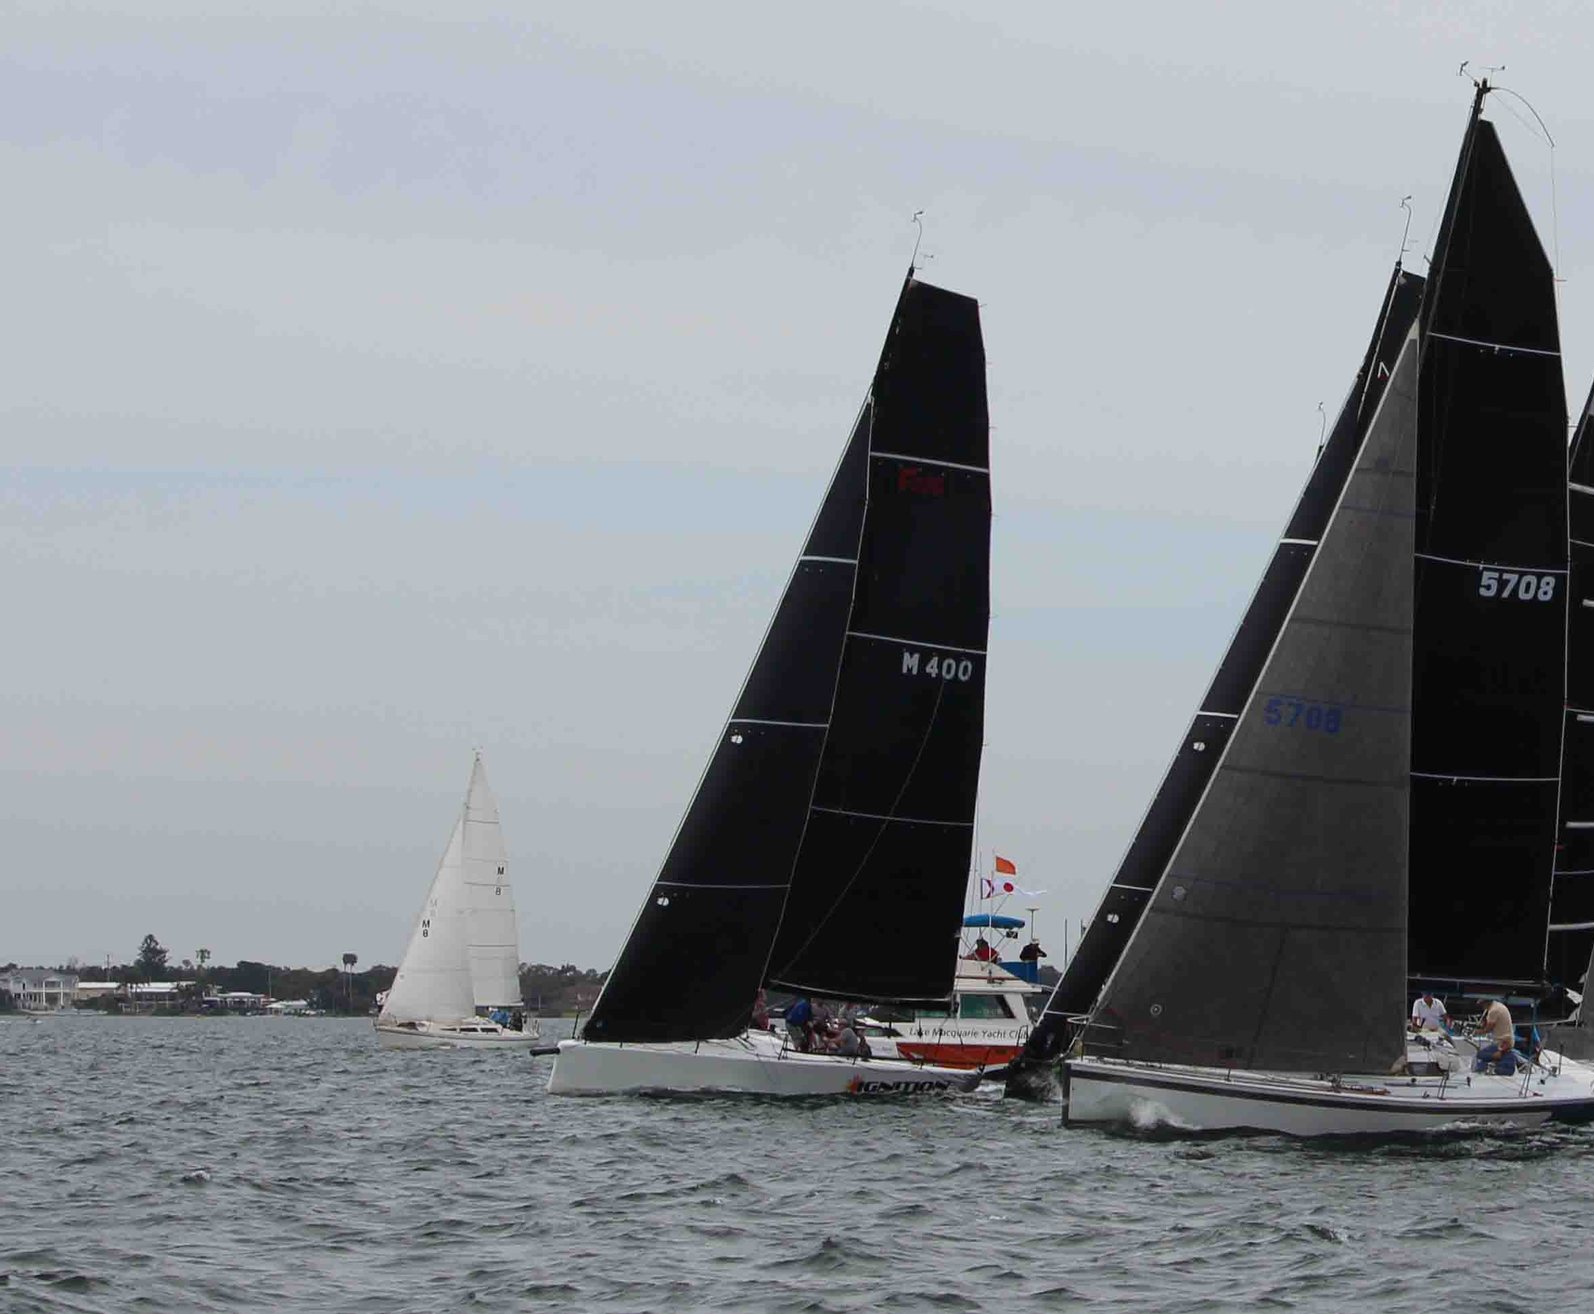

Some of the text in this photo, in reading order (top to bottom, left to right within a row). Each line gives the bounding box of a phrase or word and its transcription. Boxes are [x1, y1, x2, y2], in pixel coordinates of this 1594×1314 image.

[1479, 571, 1555, 601] 5708
[902, 652, 972, 681] M 400
[1264, 696, 1341, 733] 5708
[422, 920, 430, 928] M
[909, 1027, 930, 1037] Lae
[931, 1028, 979, 1039] Macquarie
[983, 1029, 1007, 1040] Yacht
[857, 1080, 951, 1094] IGNITION
